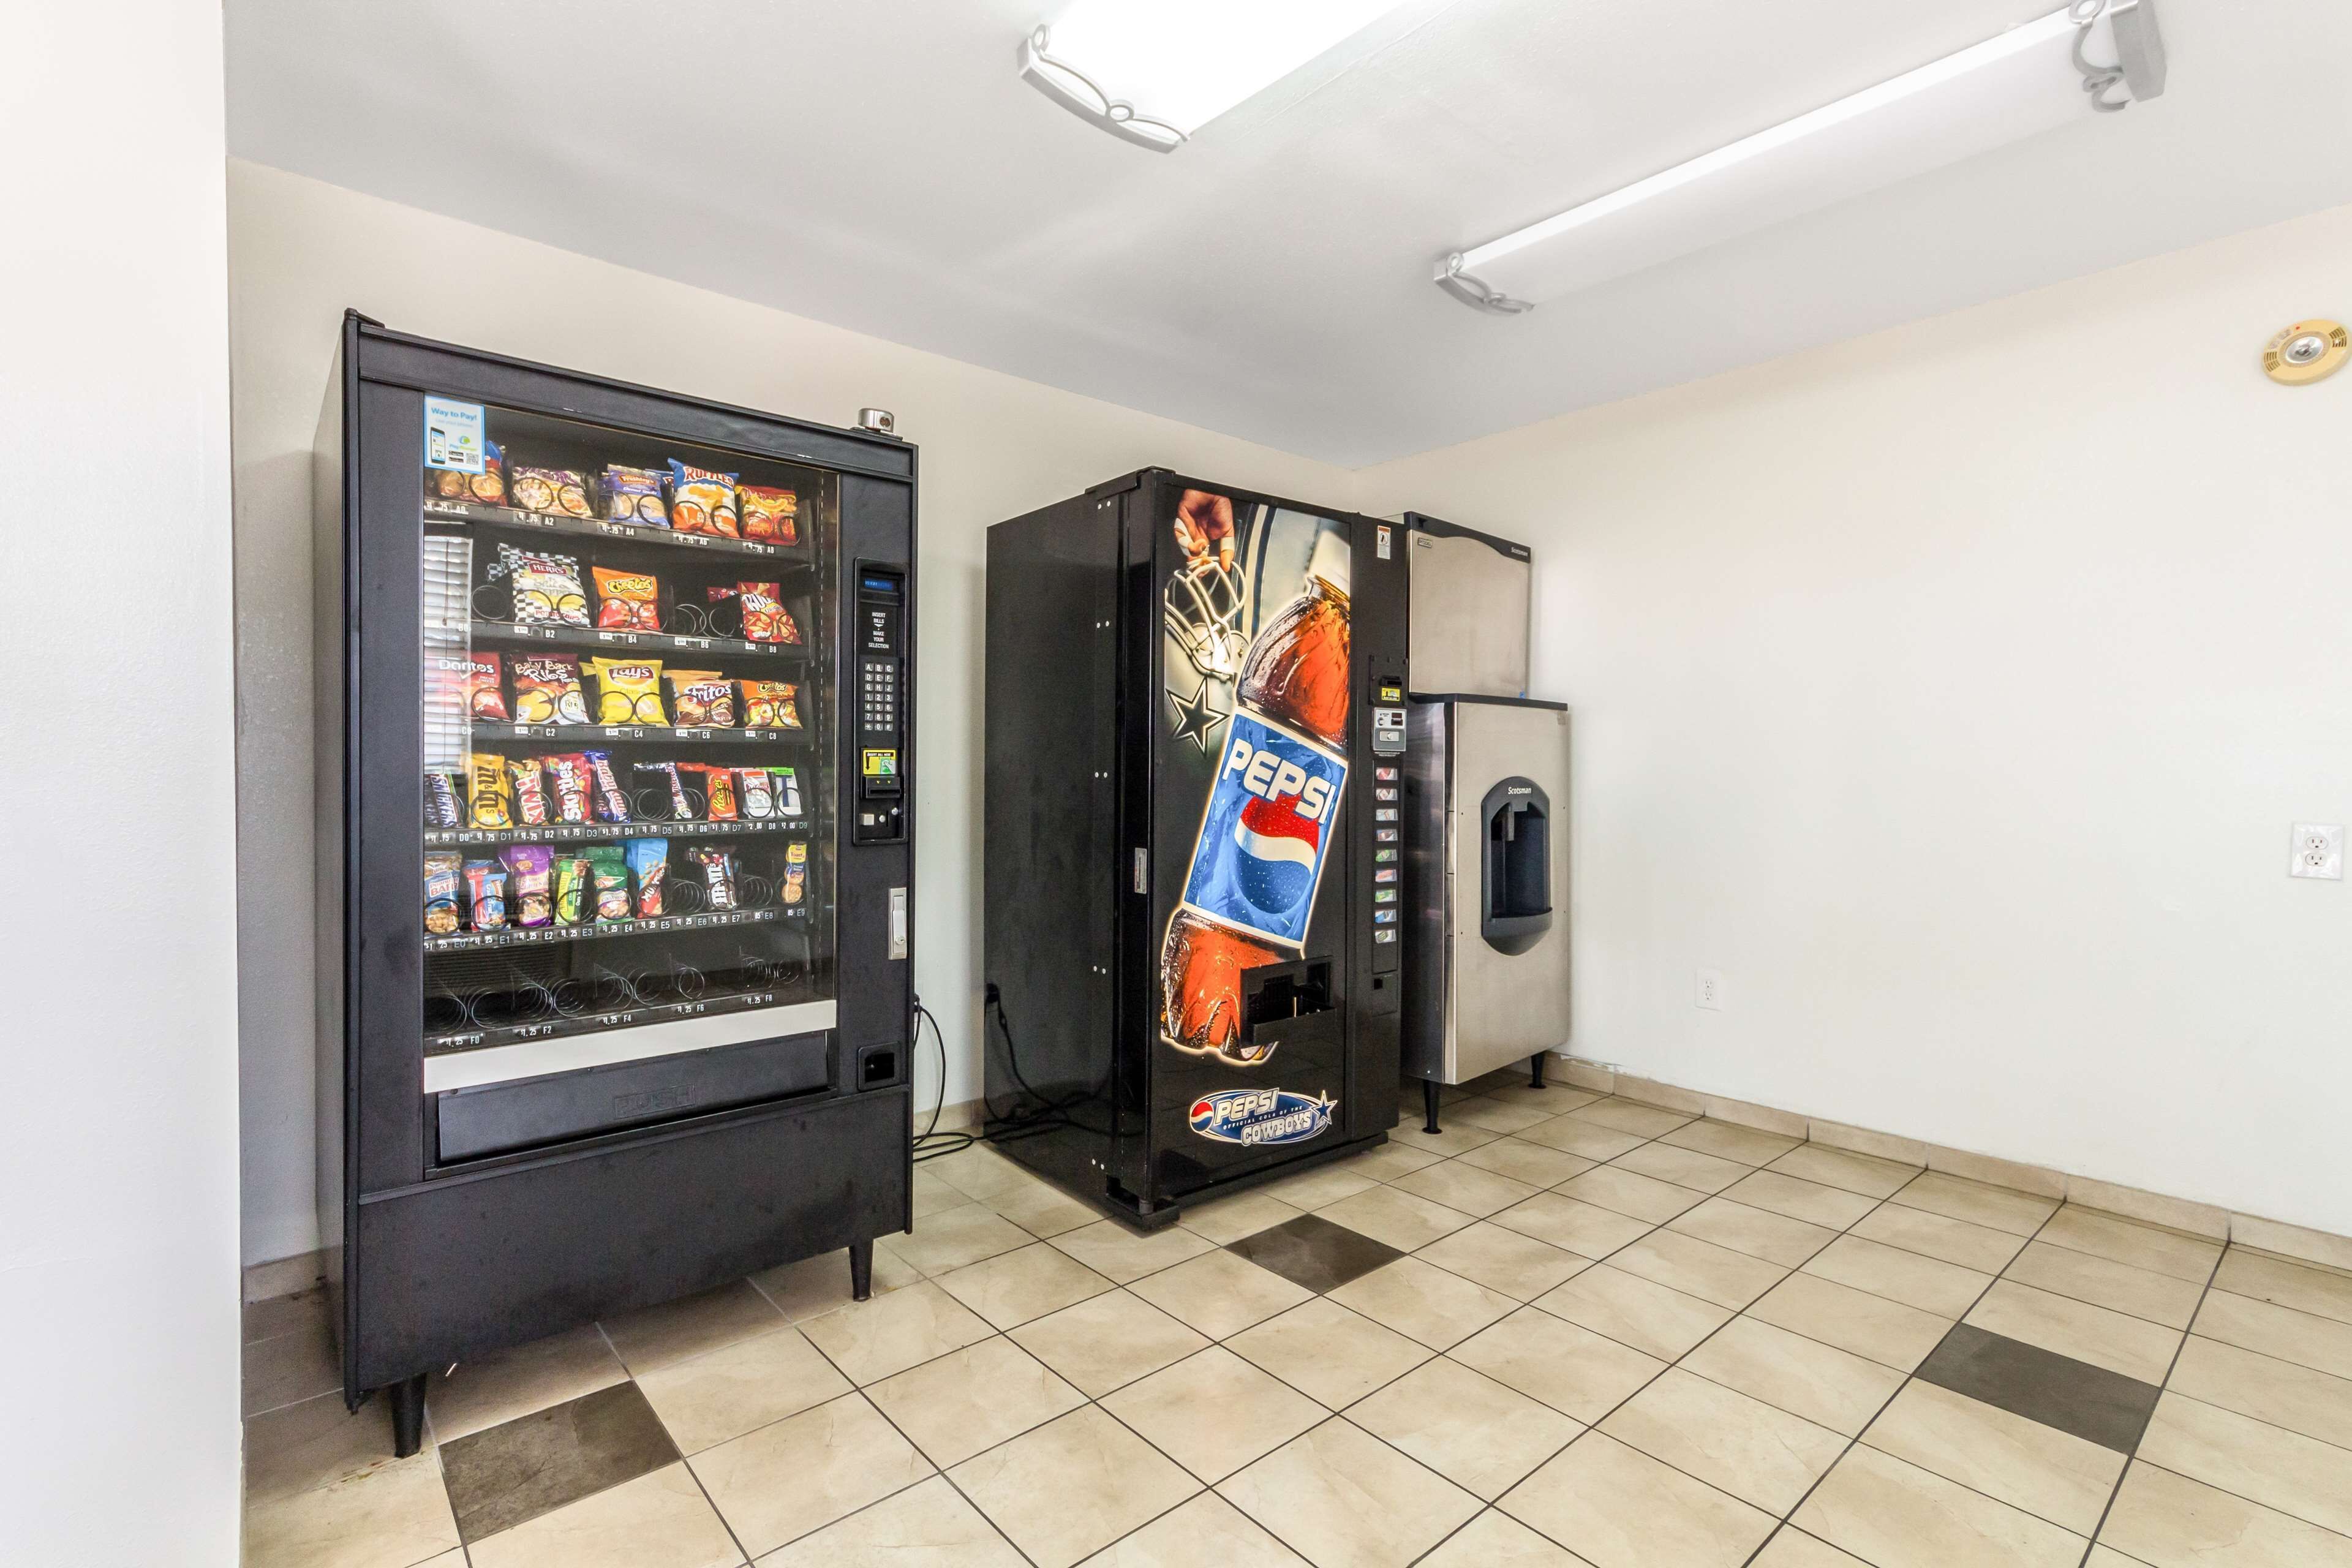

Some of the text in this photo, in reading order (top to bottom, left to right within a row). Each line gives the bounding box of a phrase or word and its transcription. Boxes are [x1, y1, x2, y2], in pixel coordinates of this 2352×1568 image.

[431, 407, 448, 417] Way
[461, 412, 477, 421] Pay!
[545, 517, 554, 526] A2
[626, 527, 635, 536] A4
[701, 640, 709, 649] B6
[439, 660, 494, 674] Doritos
[515, 660, 575, 675] Baby Back
[1222, 737, 1336, 824] PEPSI
[603, 827, 619, 836] $1.75
[470, 1036, 480, 1044] F0
[1215, 1088, 1279, 1126] PEPSI
[1223, 1118, 1255, 1130] OFFICIAL
[1242, 1110, 1312, 1146] COWBOYS
